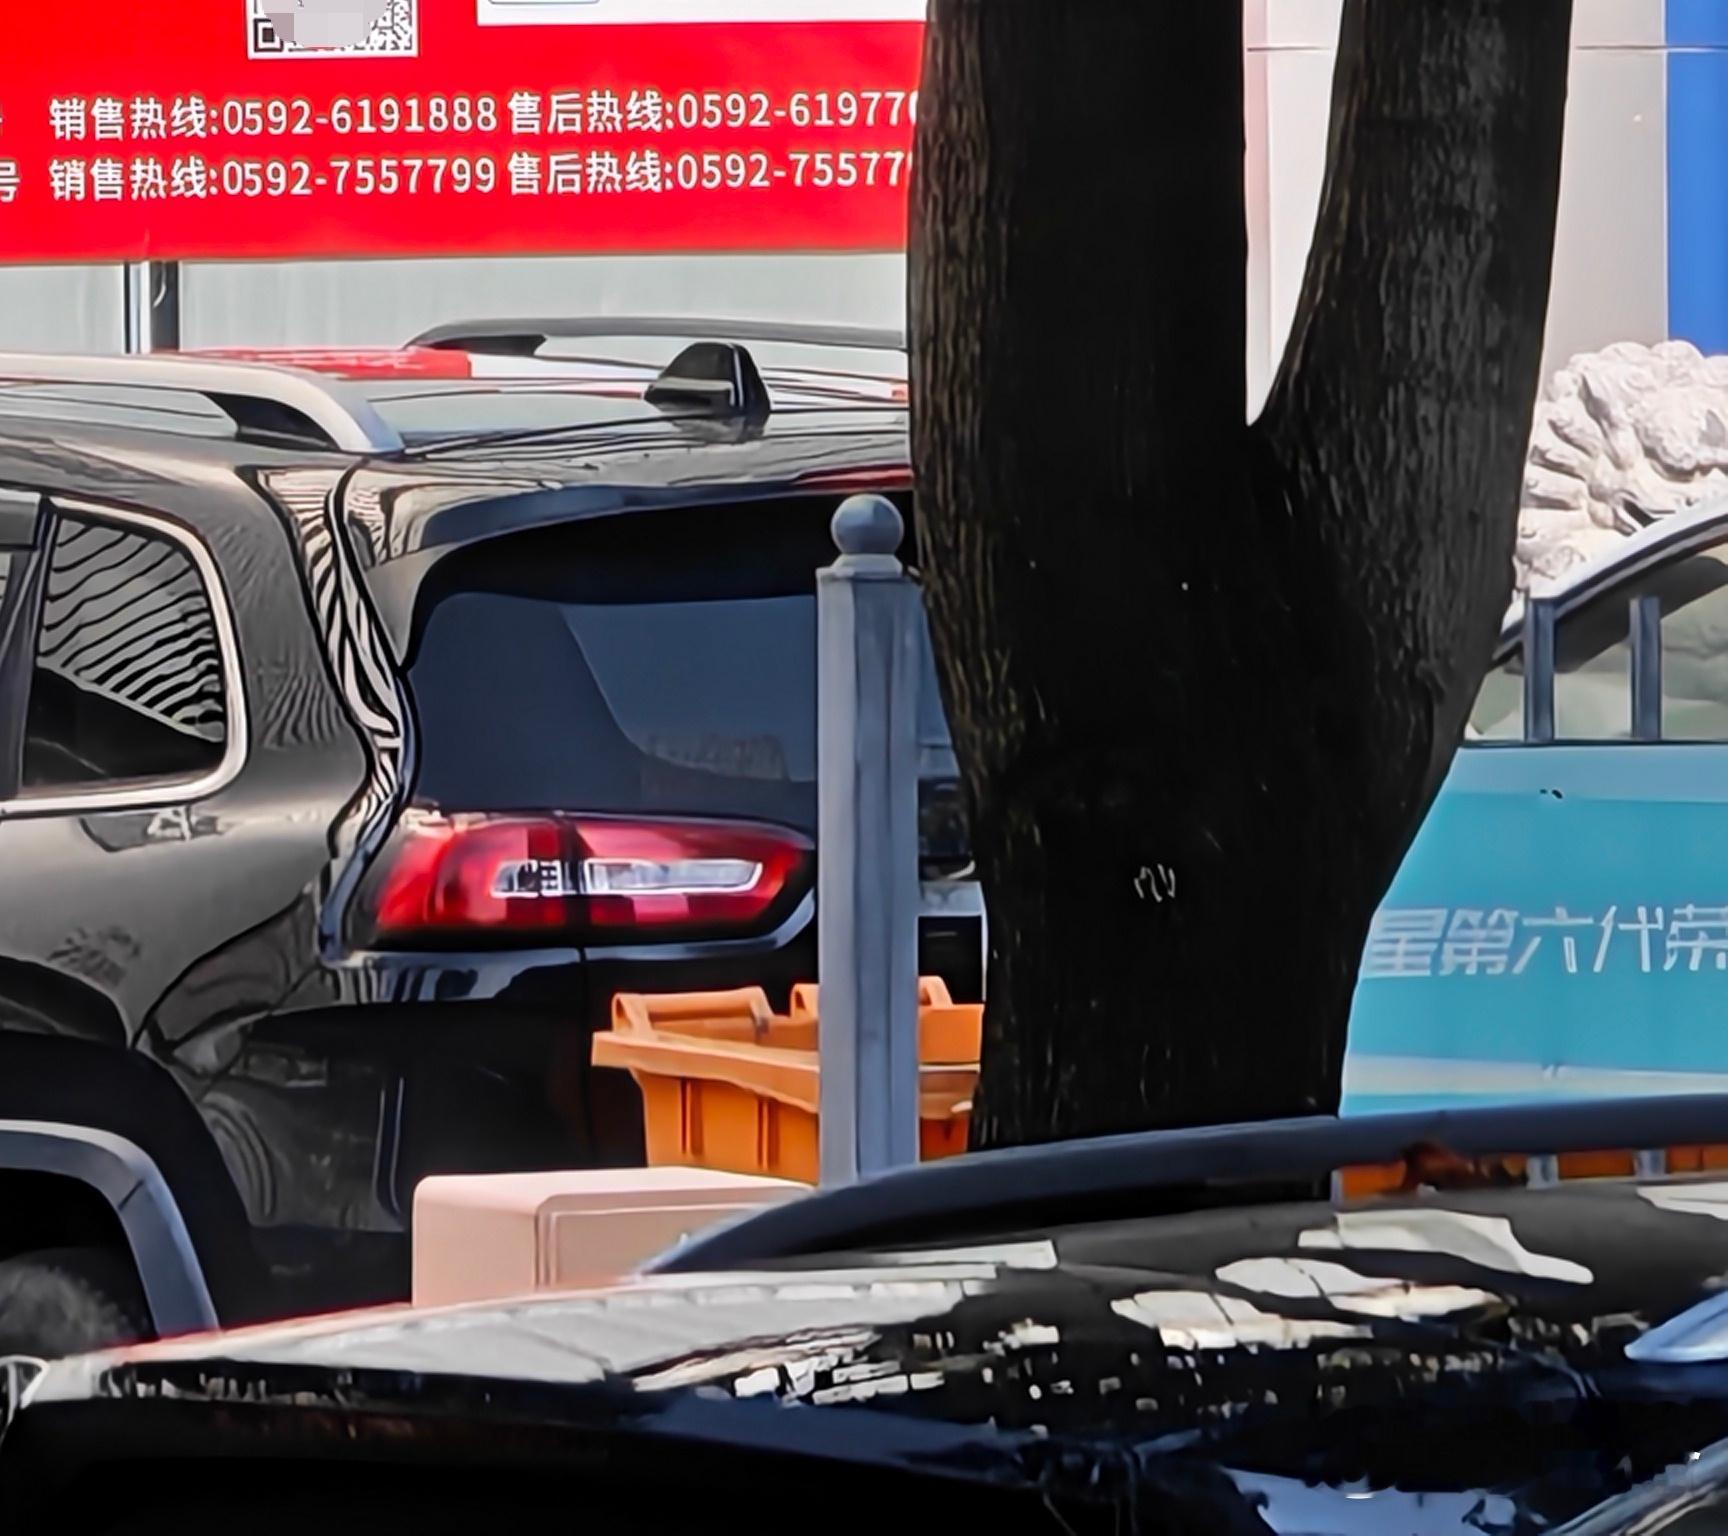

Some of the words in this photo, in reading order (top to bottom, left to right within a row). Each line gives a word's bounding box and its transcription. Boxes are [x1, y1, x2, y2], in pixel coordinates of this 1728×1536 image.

[49, 96, 497, 140] 销售热线:0592-6191888
[49, 155, 496, 200] 销售热线:0592-7557799
[507, 149, 913, 194] 售后热线:0592-75577
